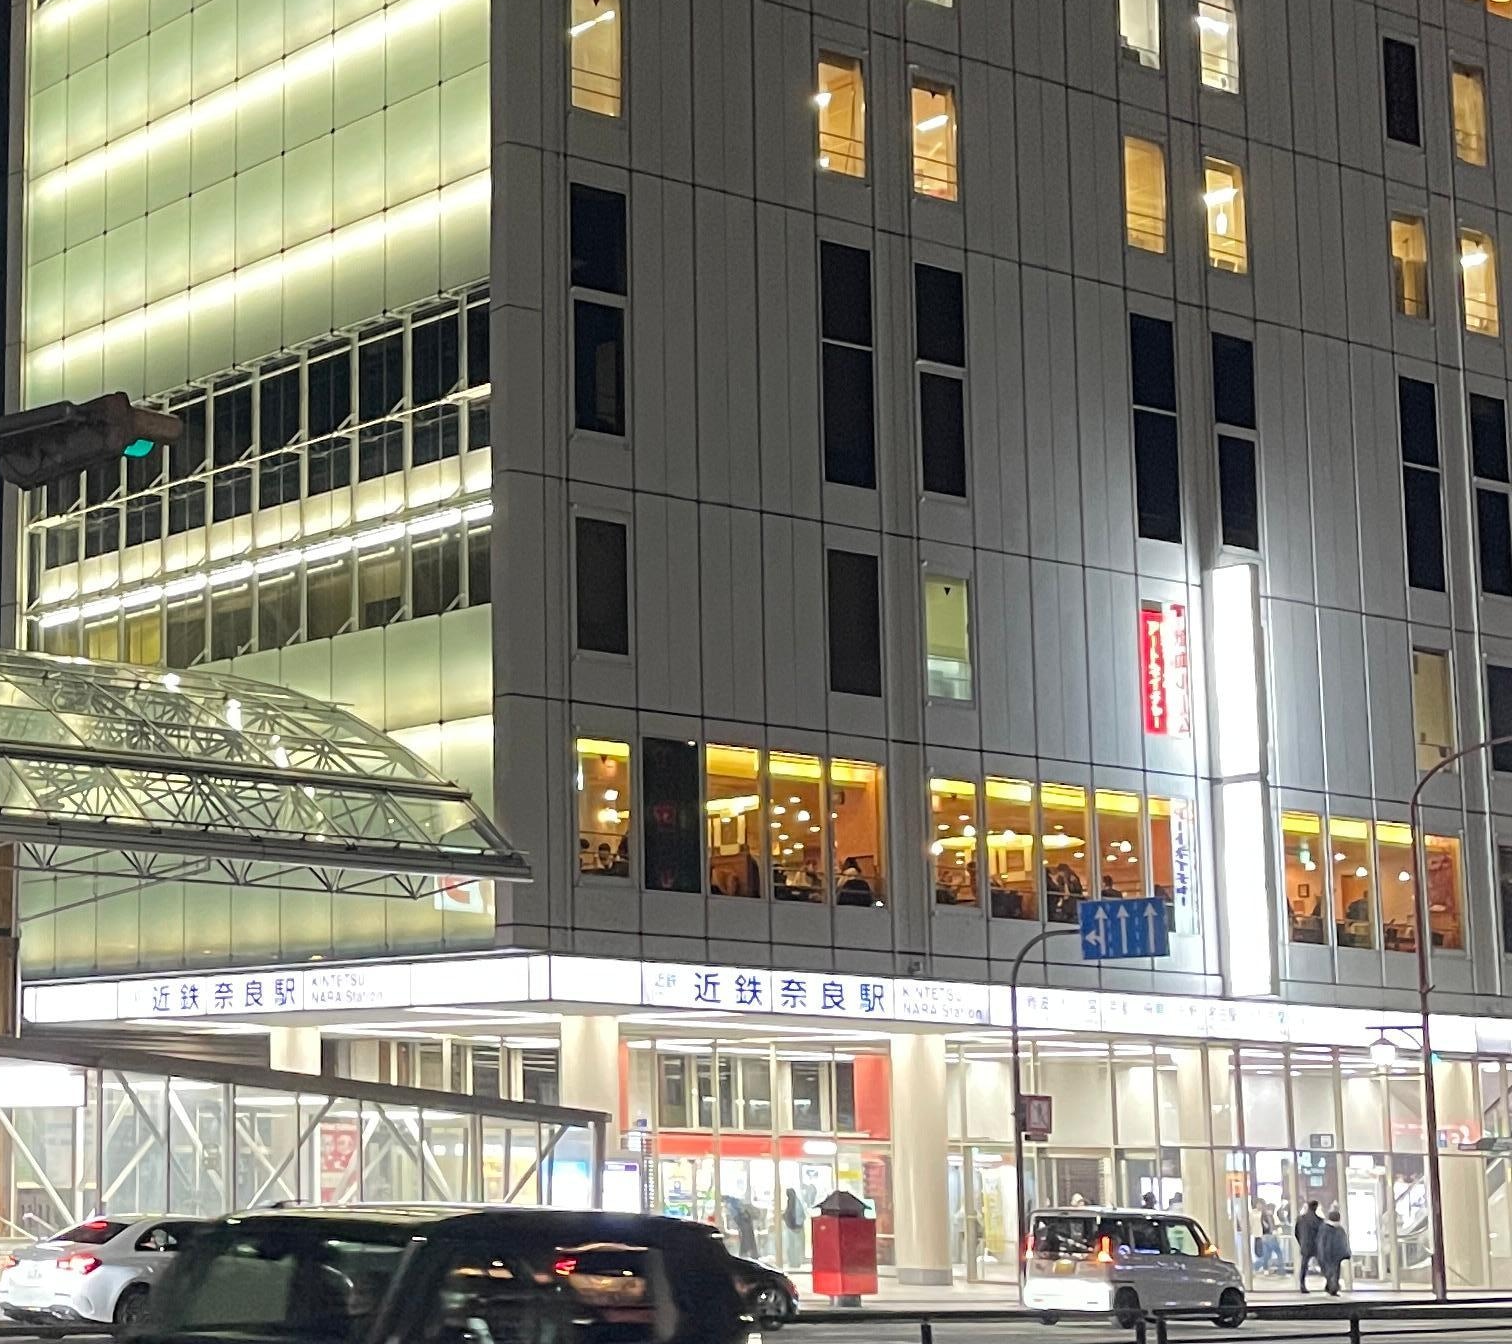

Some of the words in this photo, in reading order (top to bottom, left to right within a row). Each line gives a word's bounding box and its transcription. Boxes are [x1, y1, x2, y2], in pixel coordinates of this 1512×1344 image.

[152, 978, 296, 1012] 近鉄奈良駅
[311, 990, 342, 1003] NARA
[694, 972, 885, 1013] 近鉄奈良駅
[902, 986, 962, 1002] KNTETS
[903, 1002, 937, 1015] NARA
[942, 1003, 983, 1020] Staton
